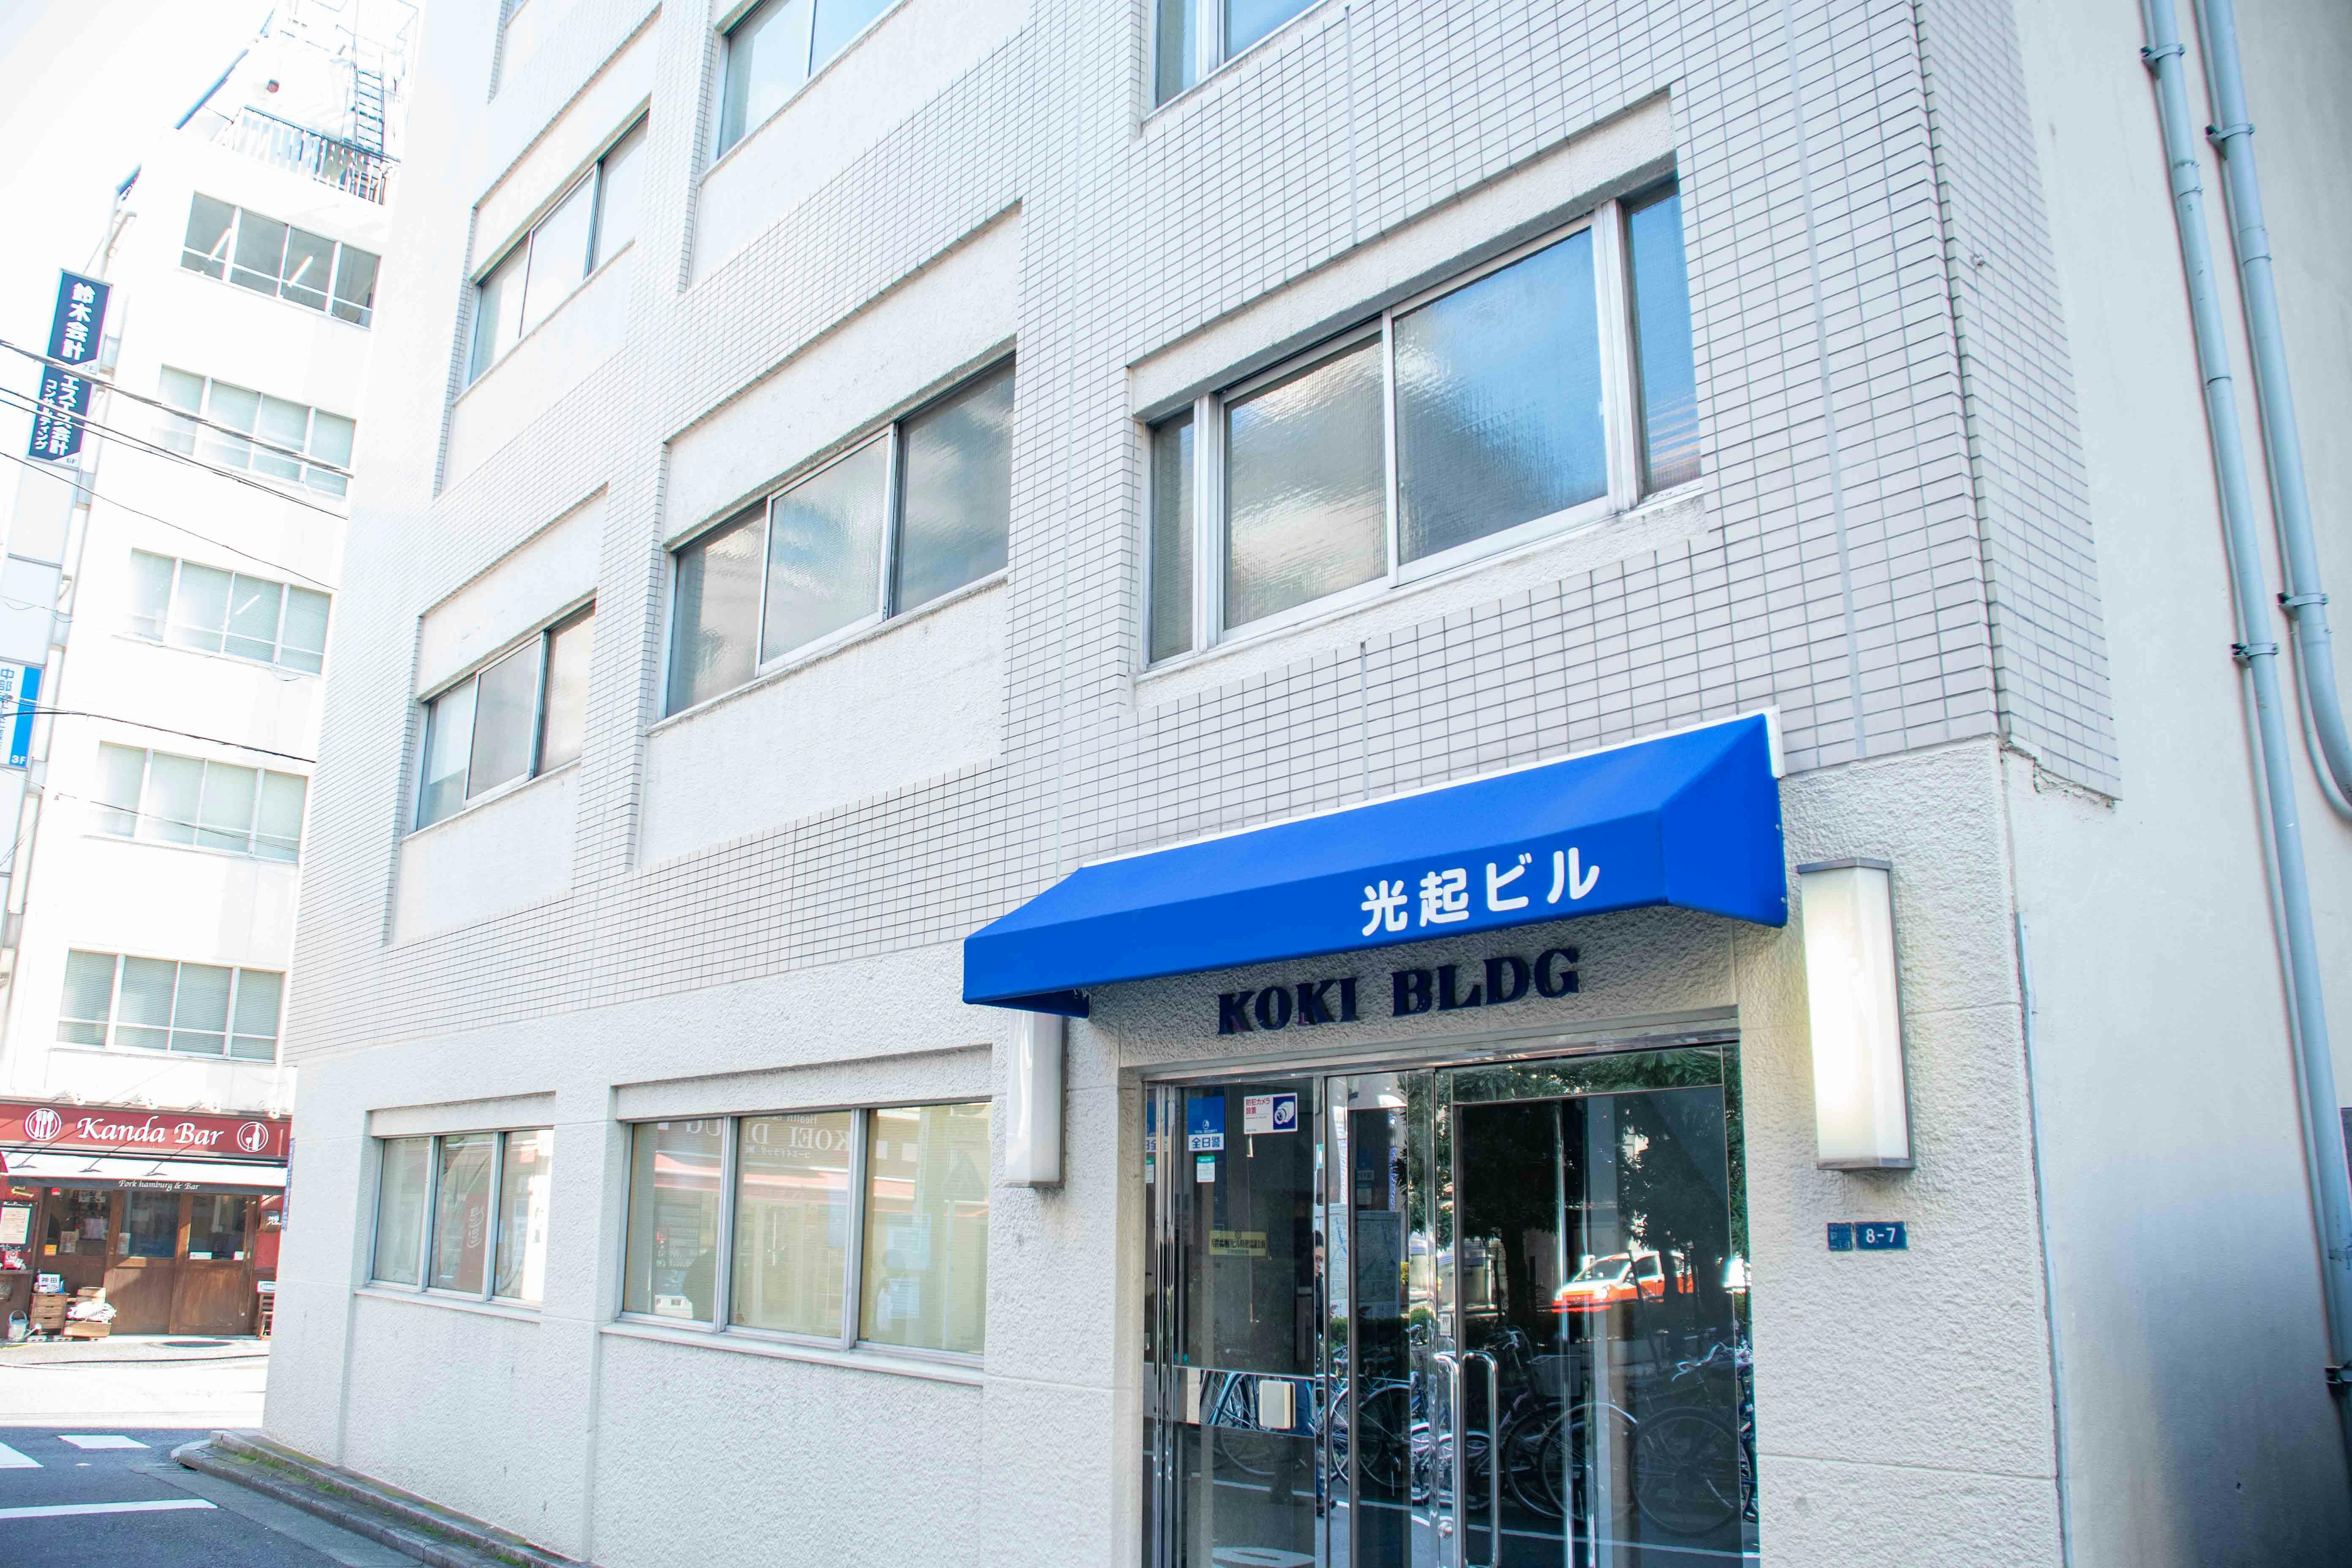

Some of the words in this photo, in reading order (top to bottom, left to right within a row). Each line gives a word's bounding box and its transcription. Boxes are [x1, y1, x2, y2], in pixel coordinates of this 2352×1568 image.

[61, 282, 96, 360] 鈴木会計
[48, 375, 79, 456] エスエス会計
[11, 755, 26, 764] 3F
[1362, 848, 1600, 936] 光起ビル
[1218, 977, 1358, 1035] KOKI
[1391, 947, 1581, 1017] BLDG
[77, 1116, 166, 1143] Kanda
[174, 1122, 224, 1146] Bar
[139, 1180, 173, 1192] hamburg
[1866, 1228, 1896, 1244] 8-7
